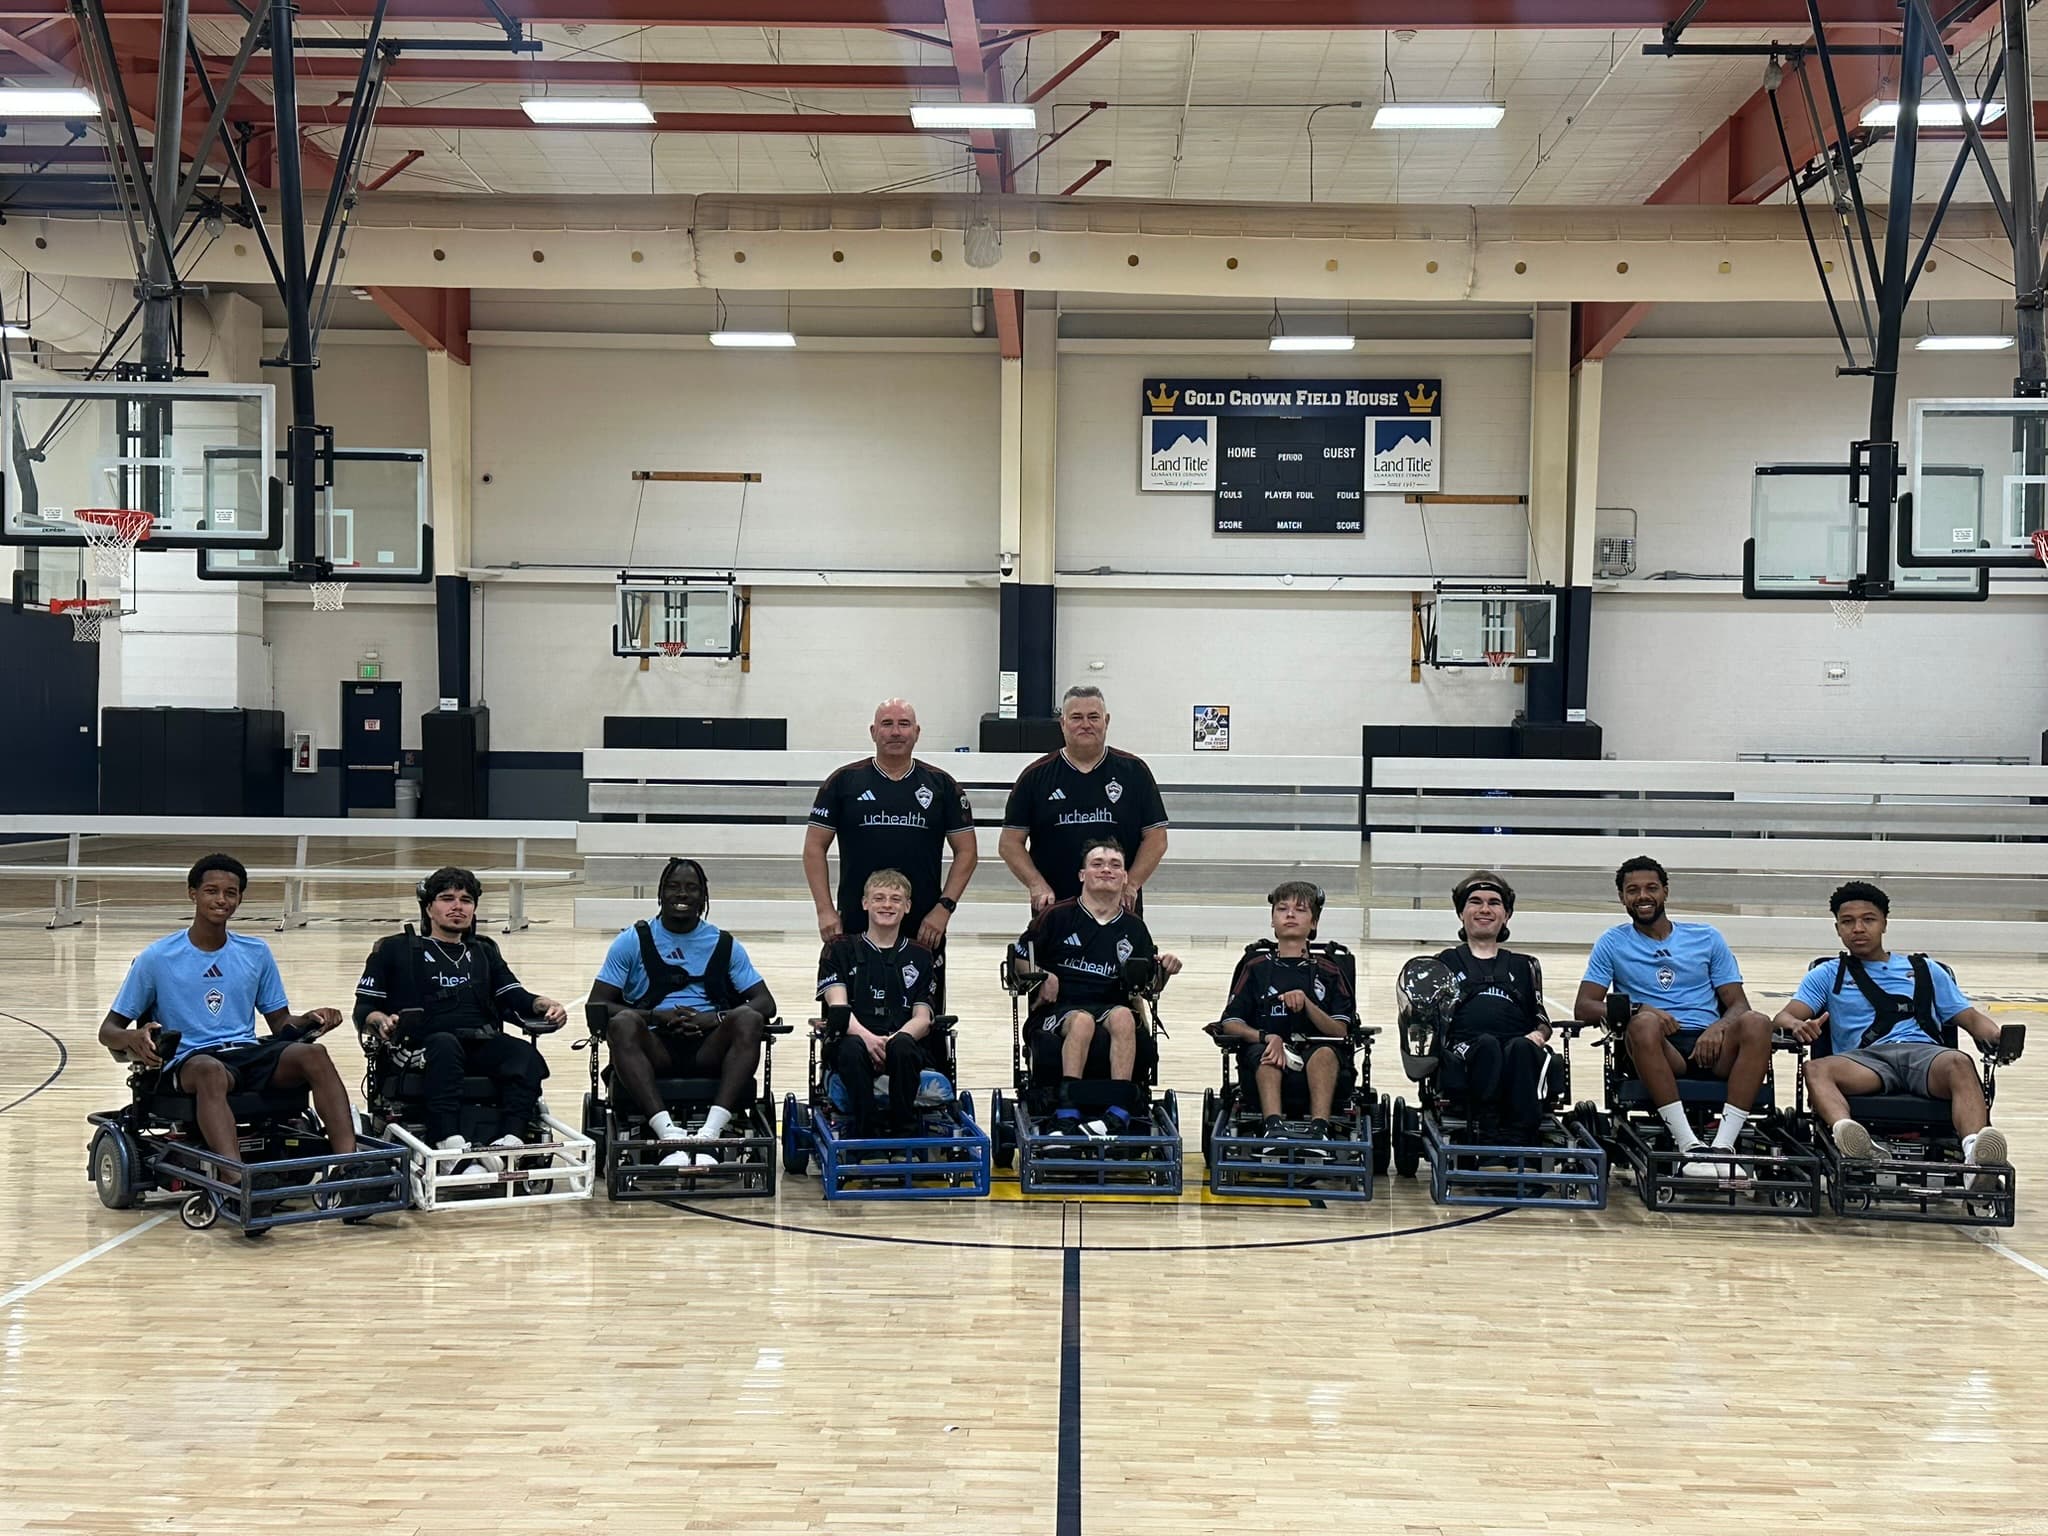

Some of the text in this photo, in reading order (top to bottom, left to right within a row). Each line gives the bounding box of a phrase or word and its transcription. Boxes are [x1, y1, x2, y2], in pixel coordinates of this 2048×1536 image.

[1227, 447, 1257, 458] HOME
[1278, 453, 1303, 461] PERIOD
[1323, 447, 1357, 459] GUEST
[1151, 456, 1209, 471] Land Title
[1374, 457, 1432, 472] Land Title
[1219, 490, 1243, 499] FOULS
[1264, 491, 1315, 499] PLAYER FOUL
[1336, 491, 1361, 499] FOULS
[1218, 521, 1243, 529] SCORE
[1276, 521, 1303, 529] MATCH
[1336, 521, 1361, 530] SCORE
[863, 810, 927, 828] uchealth
[1058, 807, 1113, 825] uchealth
